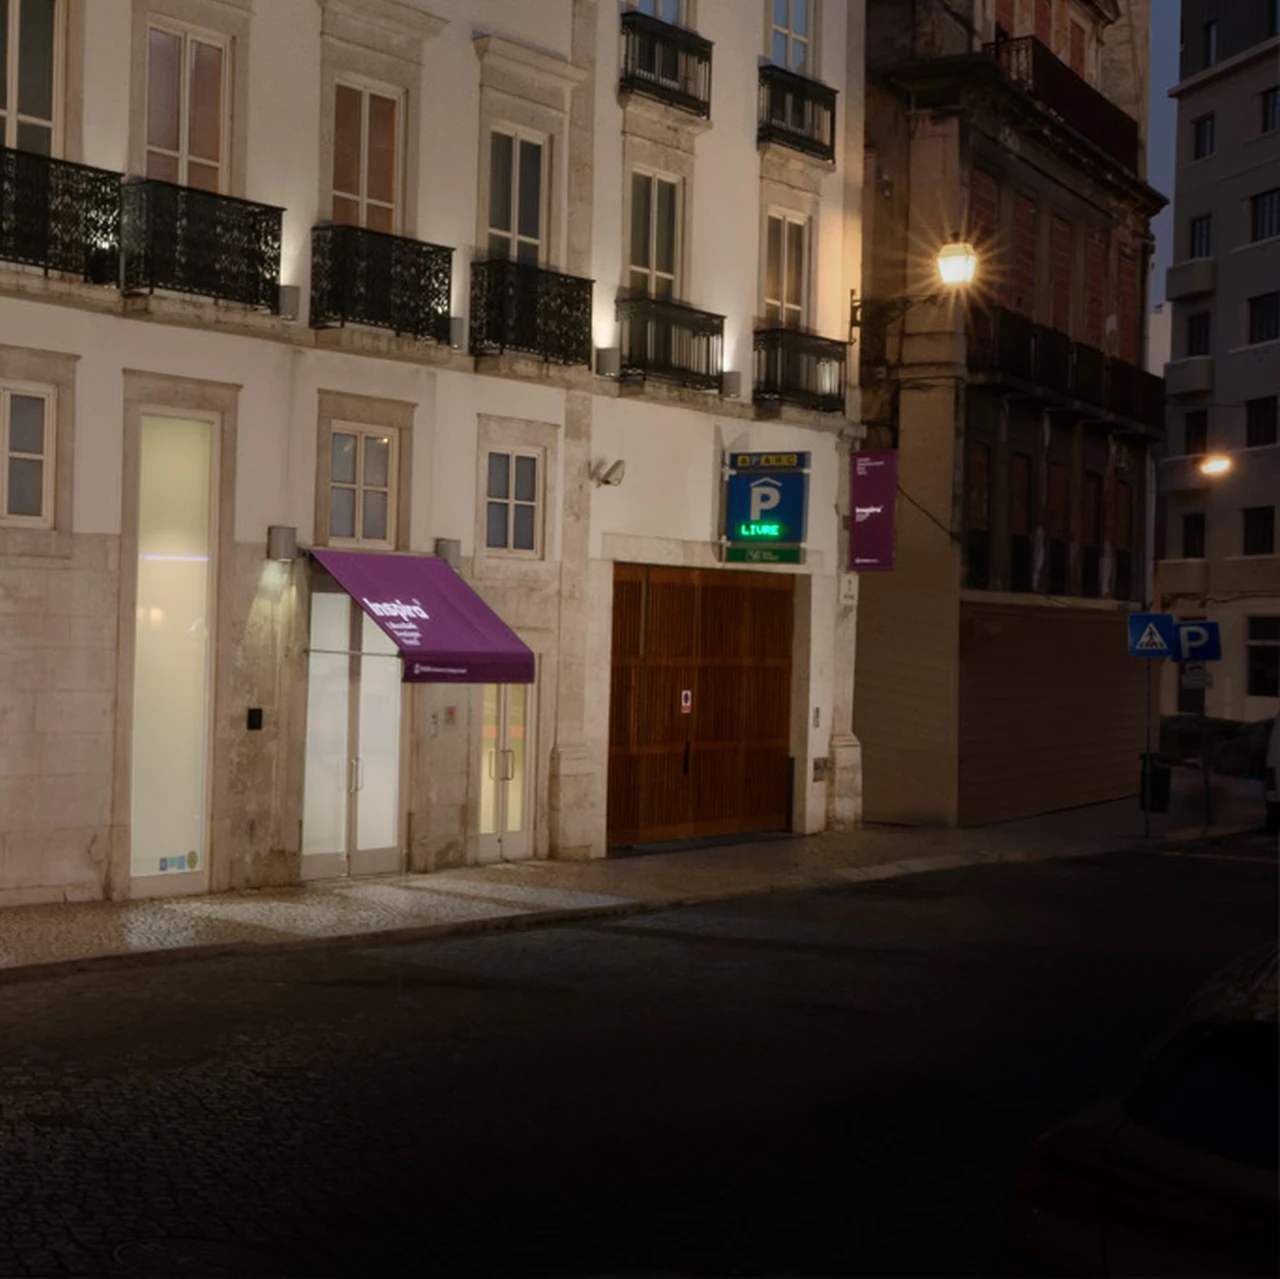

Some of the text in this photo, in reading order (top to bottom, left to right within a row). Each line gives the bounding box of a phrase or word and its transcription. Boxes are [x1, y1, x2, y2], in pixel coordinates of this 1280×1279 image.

[750, 487, 781, 521] P
[740, 524, 781, 536] LIVRE
[362, 597, 430, 622] Inspira
[1181, 625, 1209, 659] P
